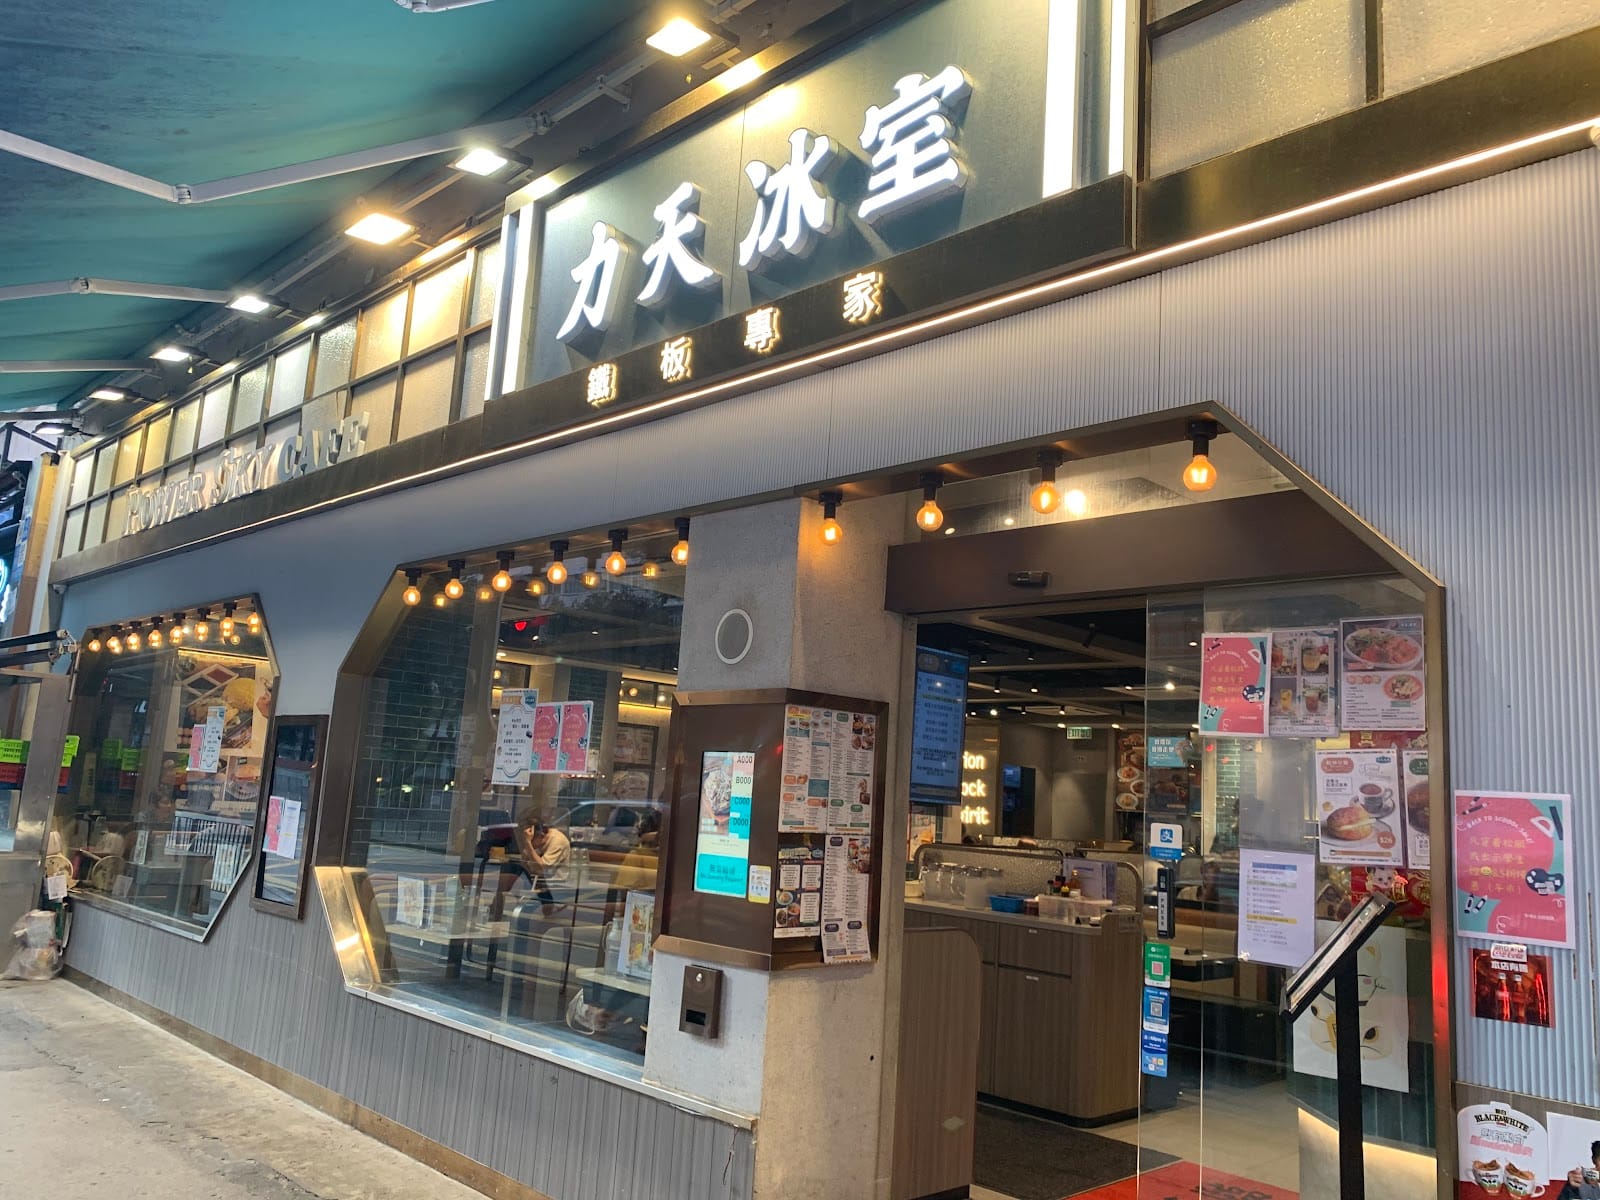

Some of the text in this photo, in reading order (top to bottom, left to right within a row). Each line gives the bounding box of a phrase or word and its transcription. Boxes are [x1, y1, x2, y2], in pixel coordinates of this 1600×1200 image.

[556, 64, 972, 341] 力天冰室
[586, 271, 884, 405] 鐵板專家
[124, 470, 207, 535] POWER
[211, 445, 278, 506] SKY
[961, 778, 987, 798] ock
[962, 751, 986, 770] ion
